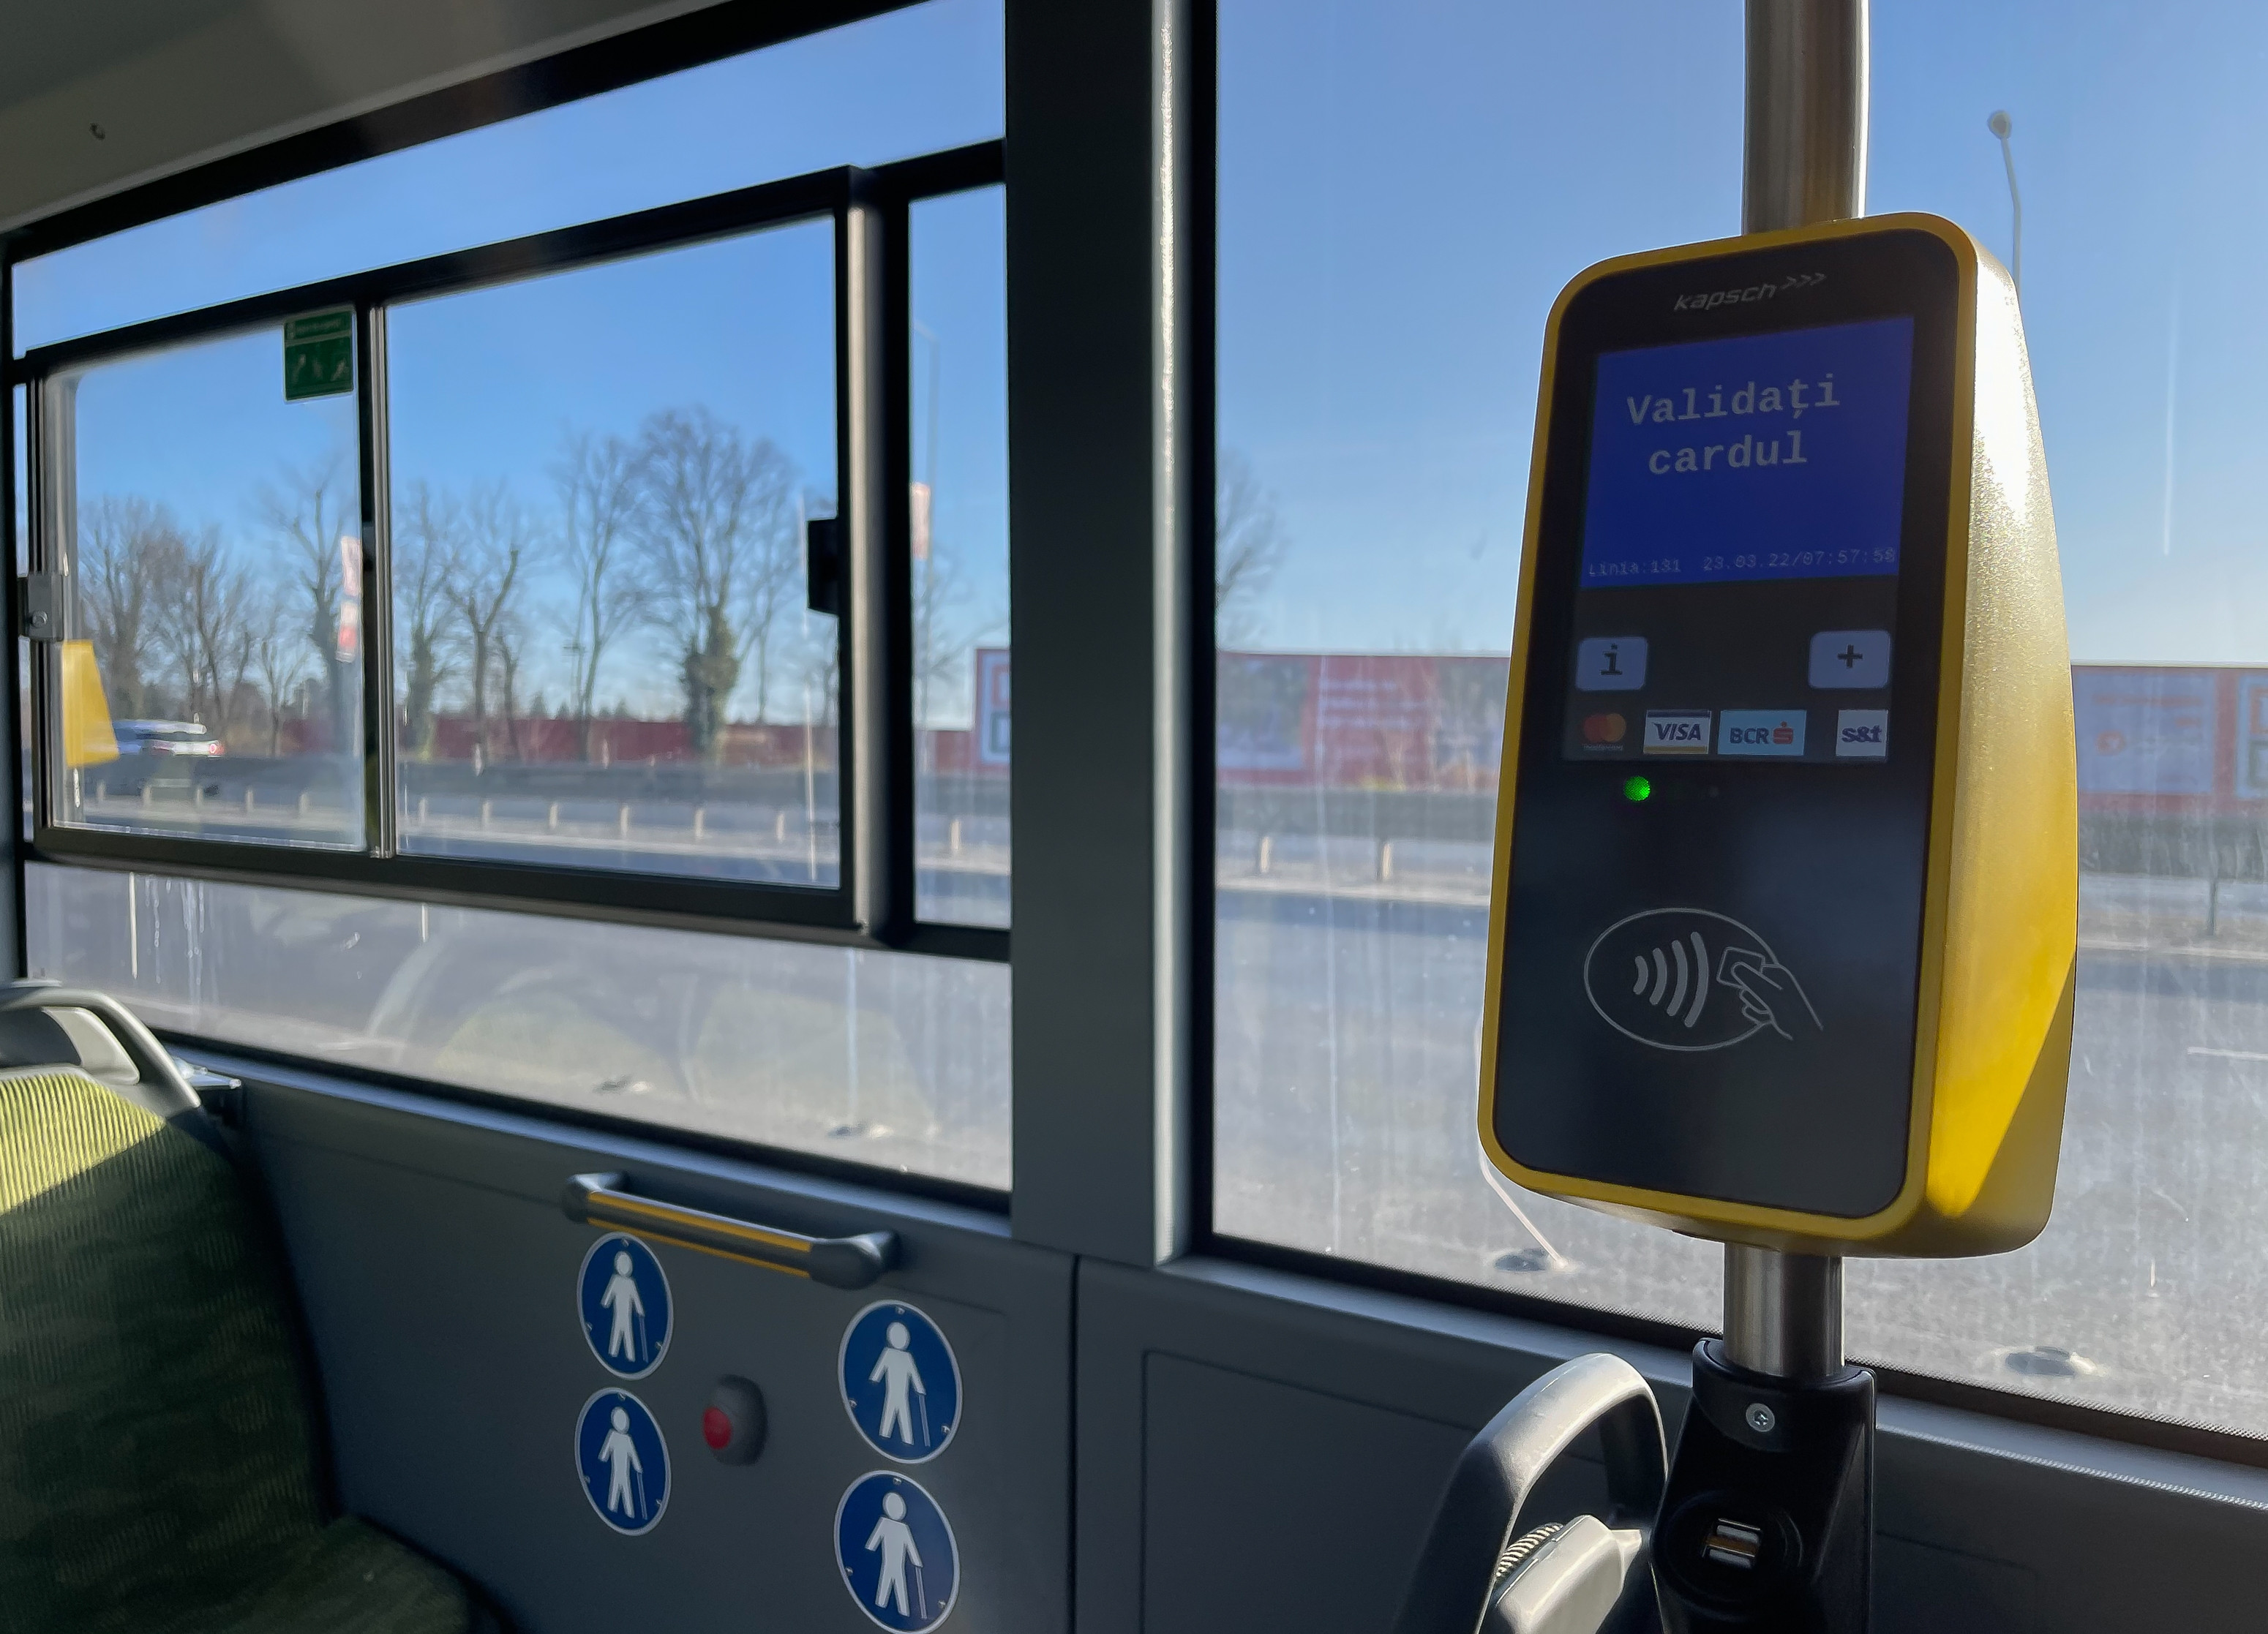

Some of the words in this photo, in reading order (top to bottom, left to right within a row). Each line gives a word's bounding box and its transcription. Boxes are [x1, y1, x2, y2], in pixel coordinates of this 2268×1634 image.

[1673, 282, 1776, 312] kapsch
[1626, 373, 1841, 425] Validați
[1648, 430, 1808, 475] cardul
[1653, 723, 1702, 742] VISA
[1729, 728, 1770, 745] BCR
